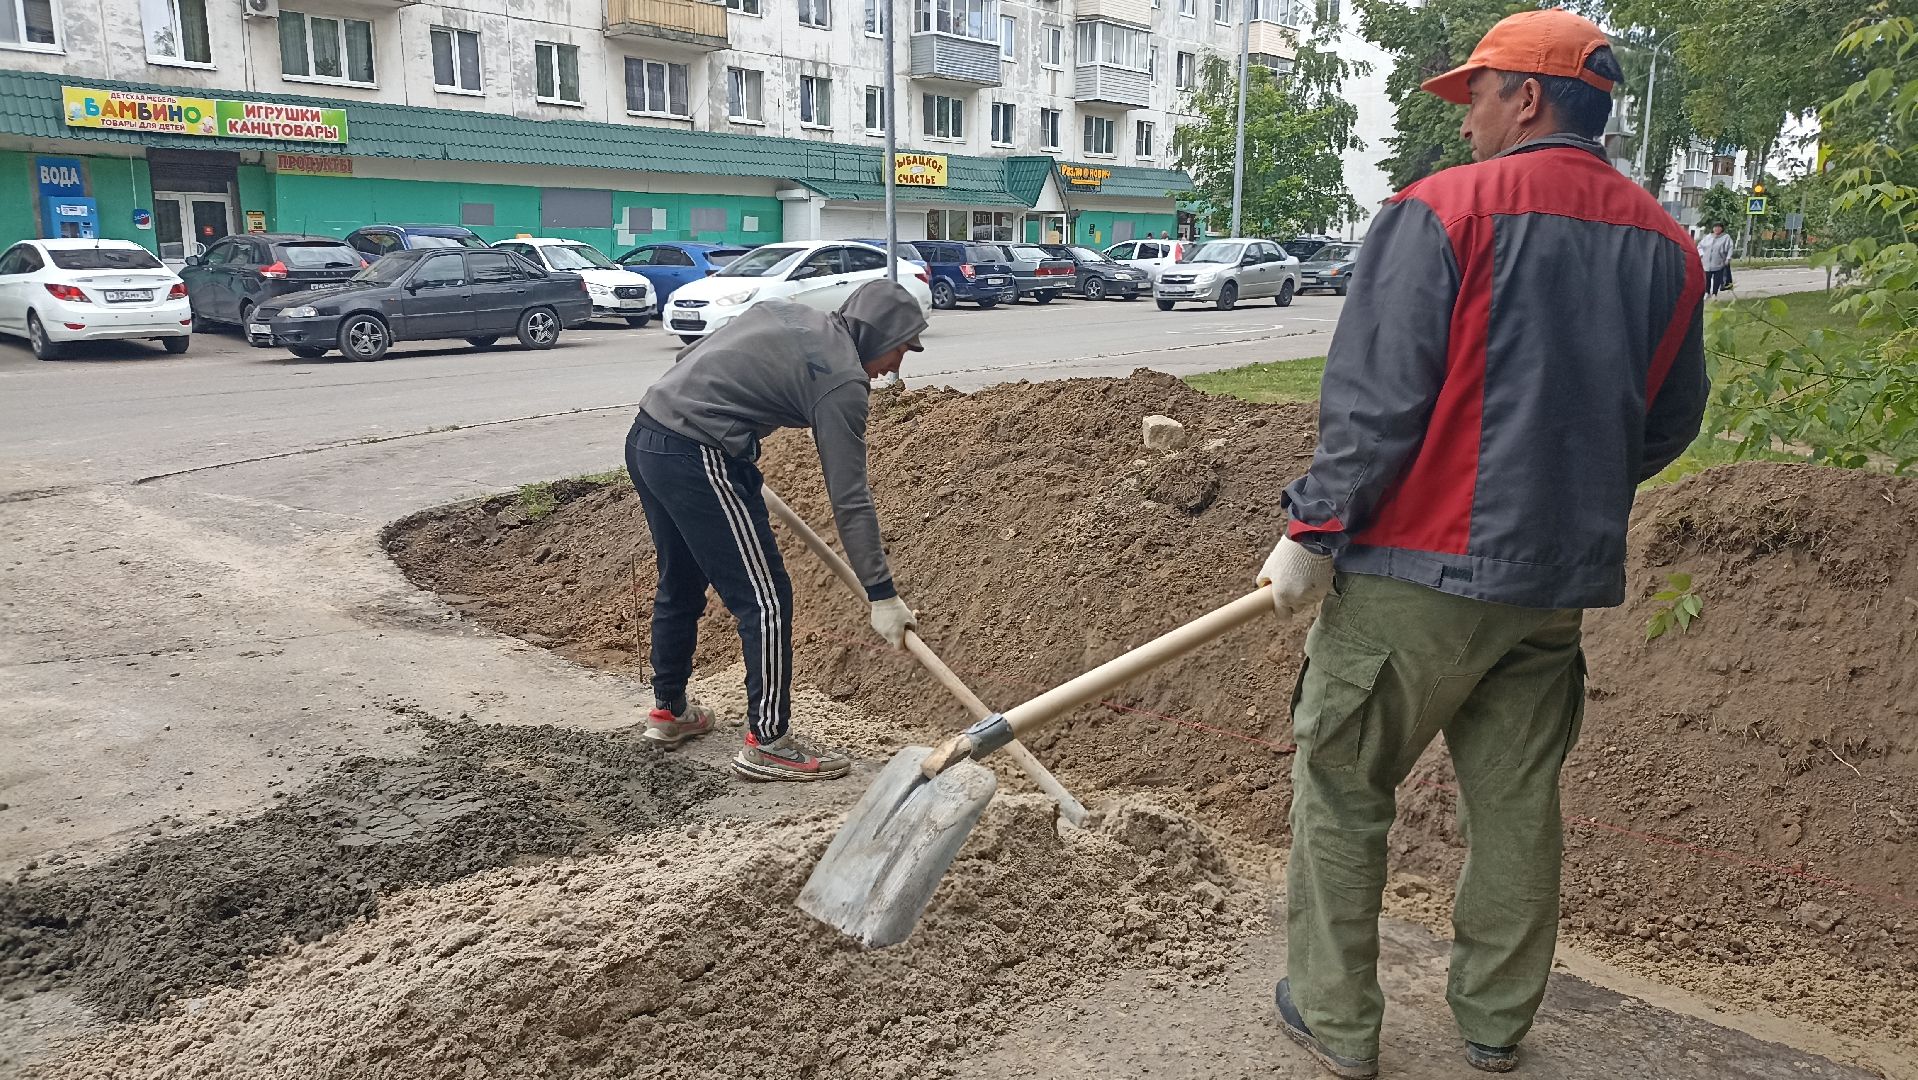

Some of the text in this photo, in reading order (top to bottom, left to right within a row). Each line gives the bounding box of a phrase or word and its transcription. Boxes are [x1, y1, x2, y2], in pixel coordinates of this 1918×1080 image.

[110, 92, 177, 104] ДЕТСКАЯ МЕБЕЛЬ
[84, 97, 202, 124] БАМБИНО
[245, 104, 321, 122] ИГРУШКИ
[101, 118, 186, 131] ТОВАРЫ ДЛЯ ДЕТЕЙ
[228, 120, 338, 139] КАНЦТОВАРЫ
[277, 154, 353, 174] ПРОДУКТЫ
[895, 155, 943, 174] ЫБАЦКОЕ
[40, 165, 80, 187] ВОДА
[897, 173, 936, 185] СЧАСТЬЕ
